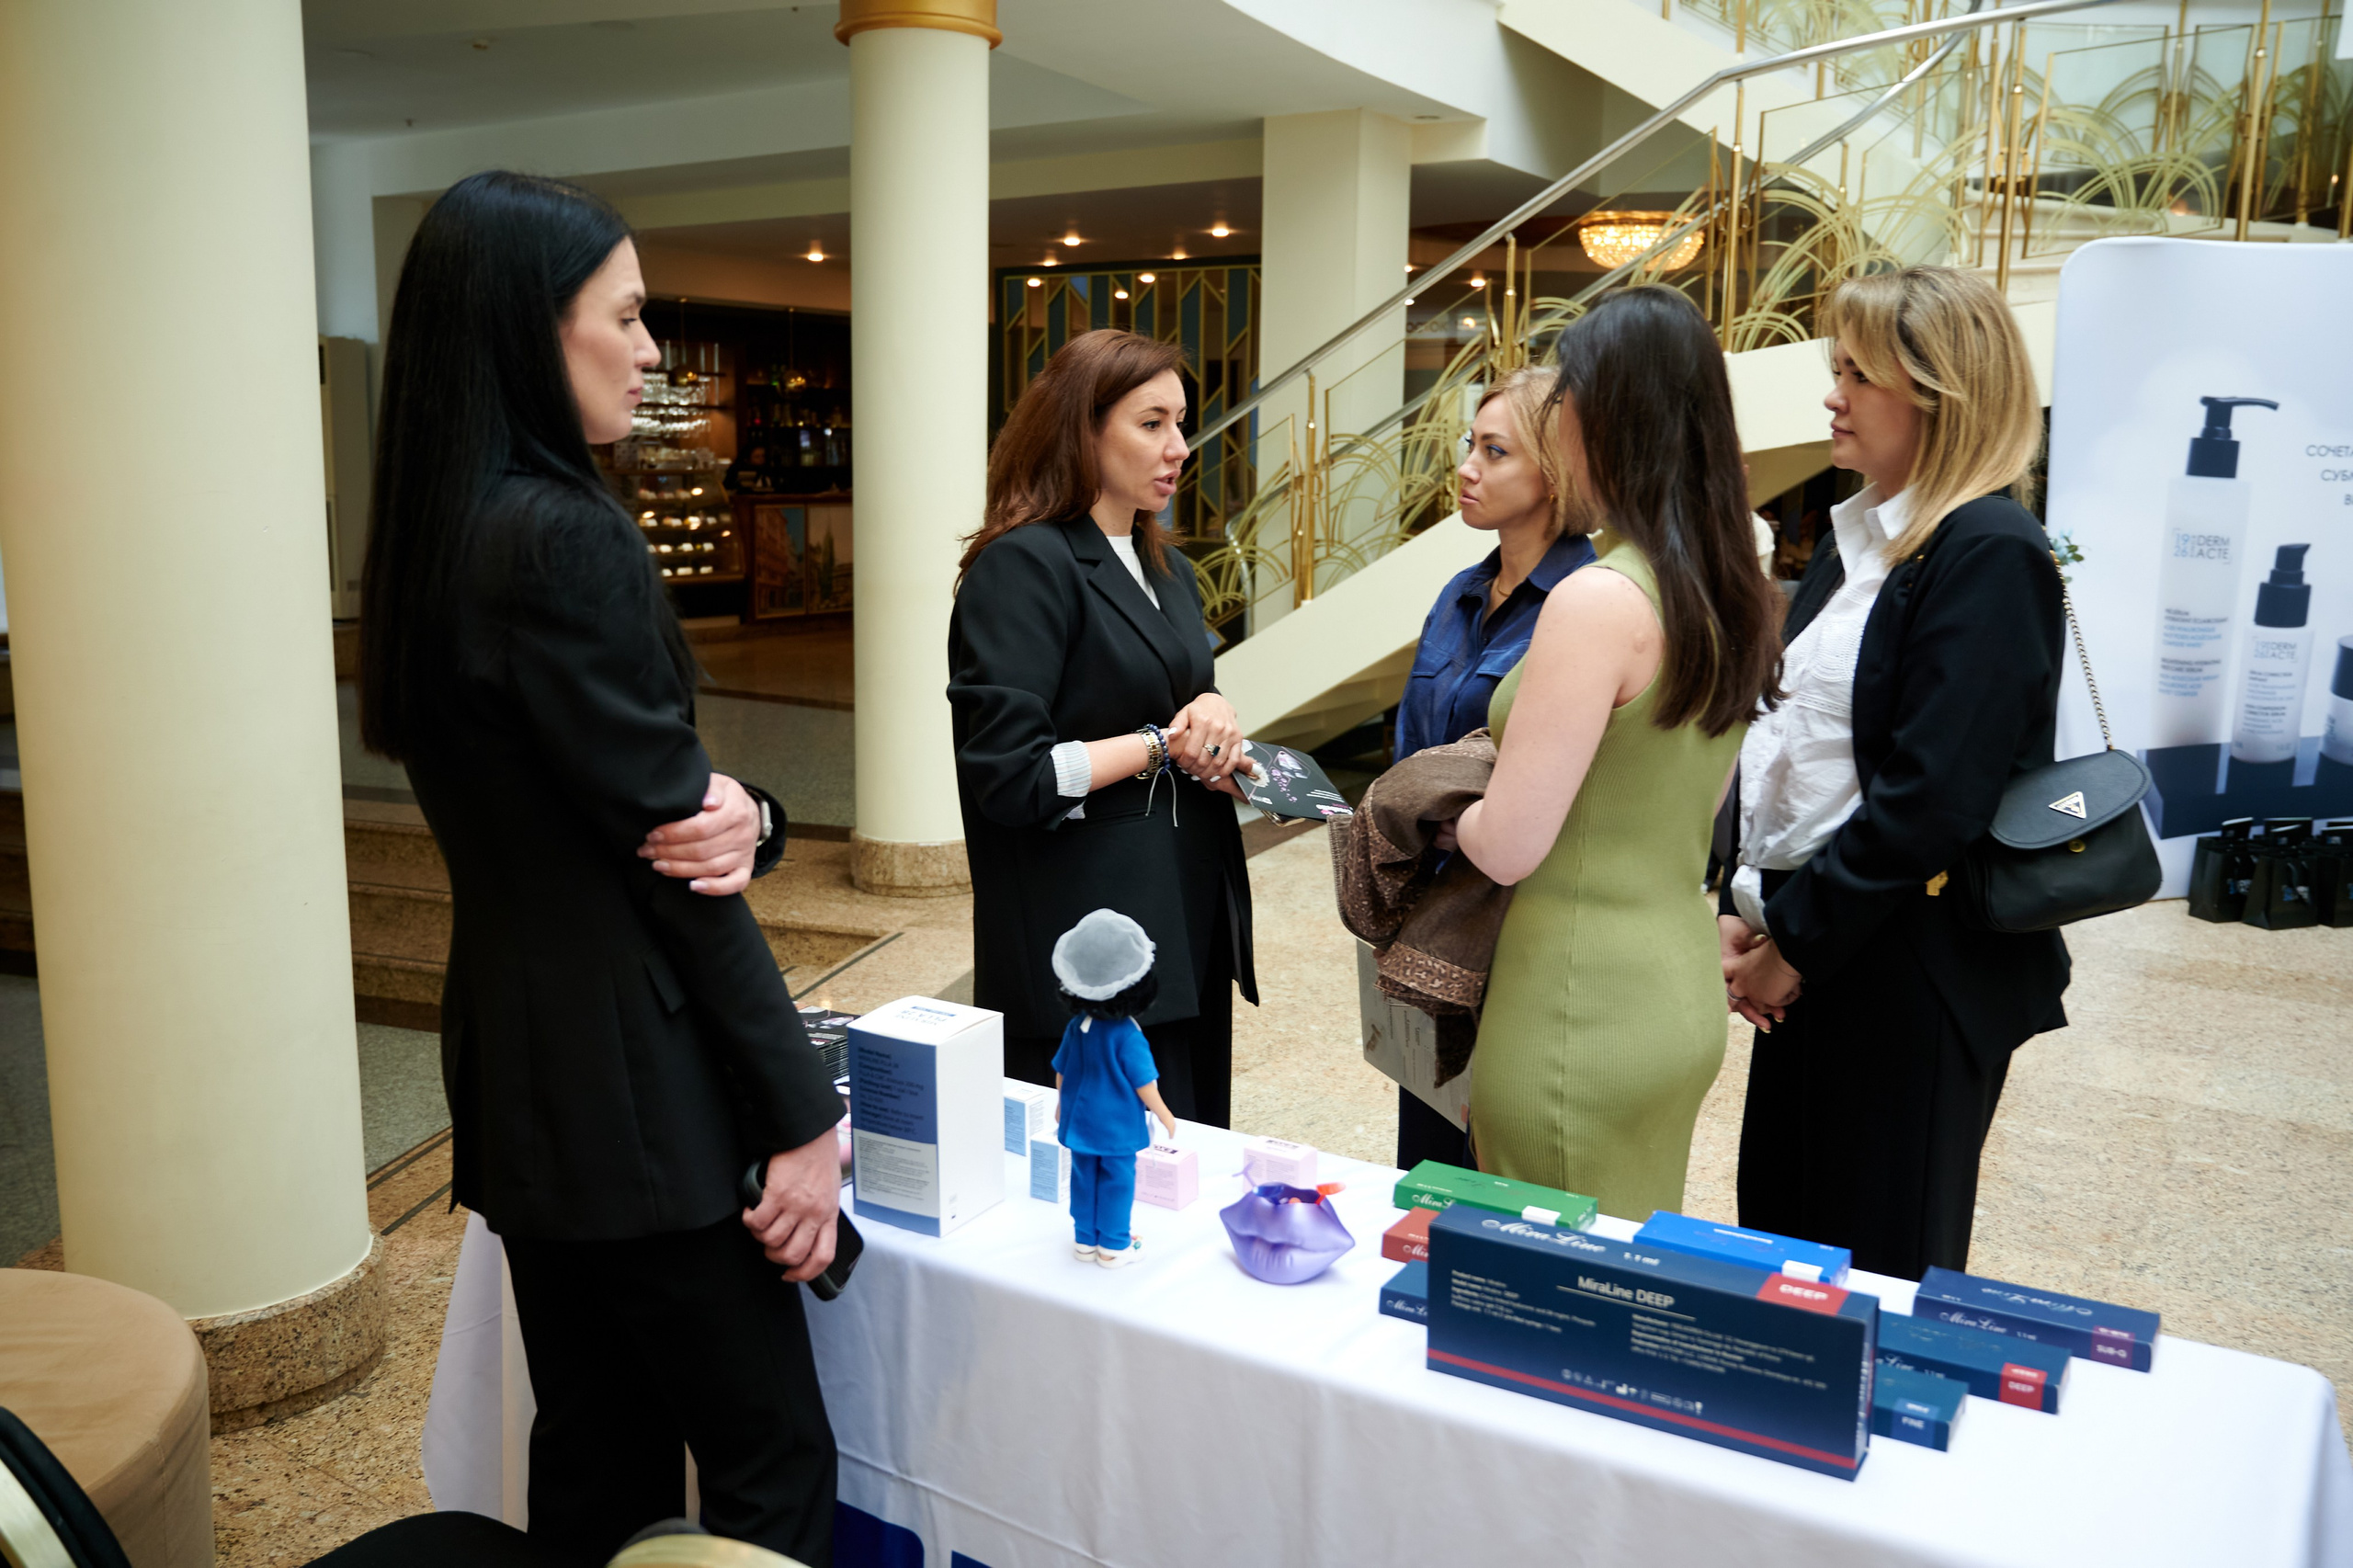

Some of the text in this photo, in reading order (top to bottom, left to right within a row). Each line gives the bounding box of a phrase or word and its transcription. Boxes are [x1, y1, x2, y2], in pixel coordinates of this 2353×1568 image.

[2198, 534, 2230, 547] DERM
[2196, 547, 2229, 560] ACTE
[1482, 1219, 1551, 1240] Mira
[1551, 1232, 1607, 1253] Line
[1577, 1276, 1676, 1308] MiraLine DEEP
[1779, 1283, 1828, 1301] DEEP
[2096, 1344, 2128, 1358] SUB-Q
[2007, 1381, 2035, 1393] DEEP
[1902, 1415, 1925, 1430] FINE
